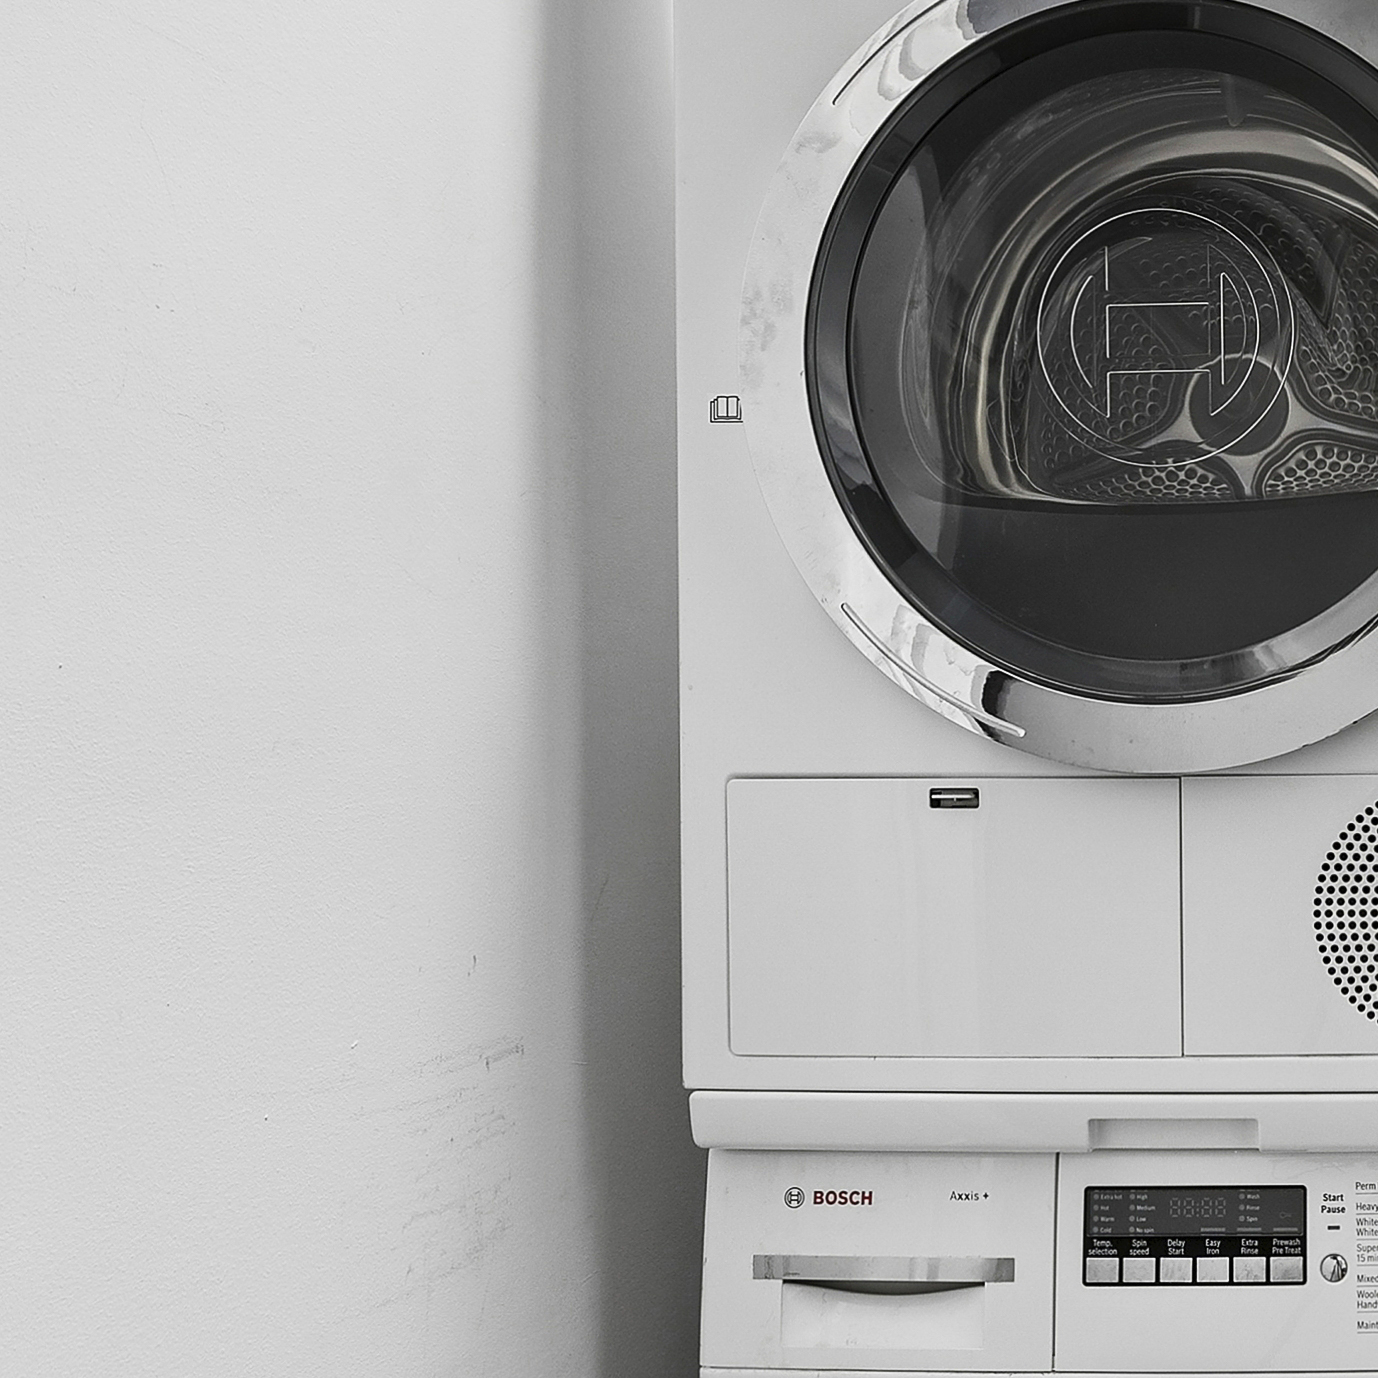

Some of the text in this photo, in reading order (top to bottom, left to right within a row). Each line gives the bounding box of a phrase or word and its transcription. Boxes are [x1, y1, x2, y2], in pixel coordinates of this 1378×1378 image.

[1355, 1182, 1376, 1191] Perm
[813, 1190, 873, 1206] BOSCH
[950, 1190, 980, 1202] Axxis
[1322, 1193, 1344, 1202] Start
[1320, 1205, 1346, 1214] Pause
[1356, 1202, 1378, 1212] Heavy
[1093, 1239, 1113, 1248] Temp.
[1132, 1239, 1148, 1248] Spin
[1167, 1238, 1186, 1248] Delay
[1205, 1238, 1221, 1248] Easy
[1241, 1238, 1259, 1246] Extra
[1272, 1238, 1301, 1246] Prewash
[1129, 1247, 1150, 1256] speed
[1168, 1247, 1185, 1255] Start
[1206, 1247, 1220, 1255] Iron
[1240, 1247, 1259, 1255] Rinse
[1284, 1246, 1302, 1254] Treat
[1356, 1254, 1365, 1262] 15
